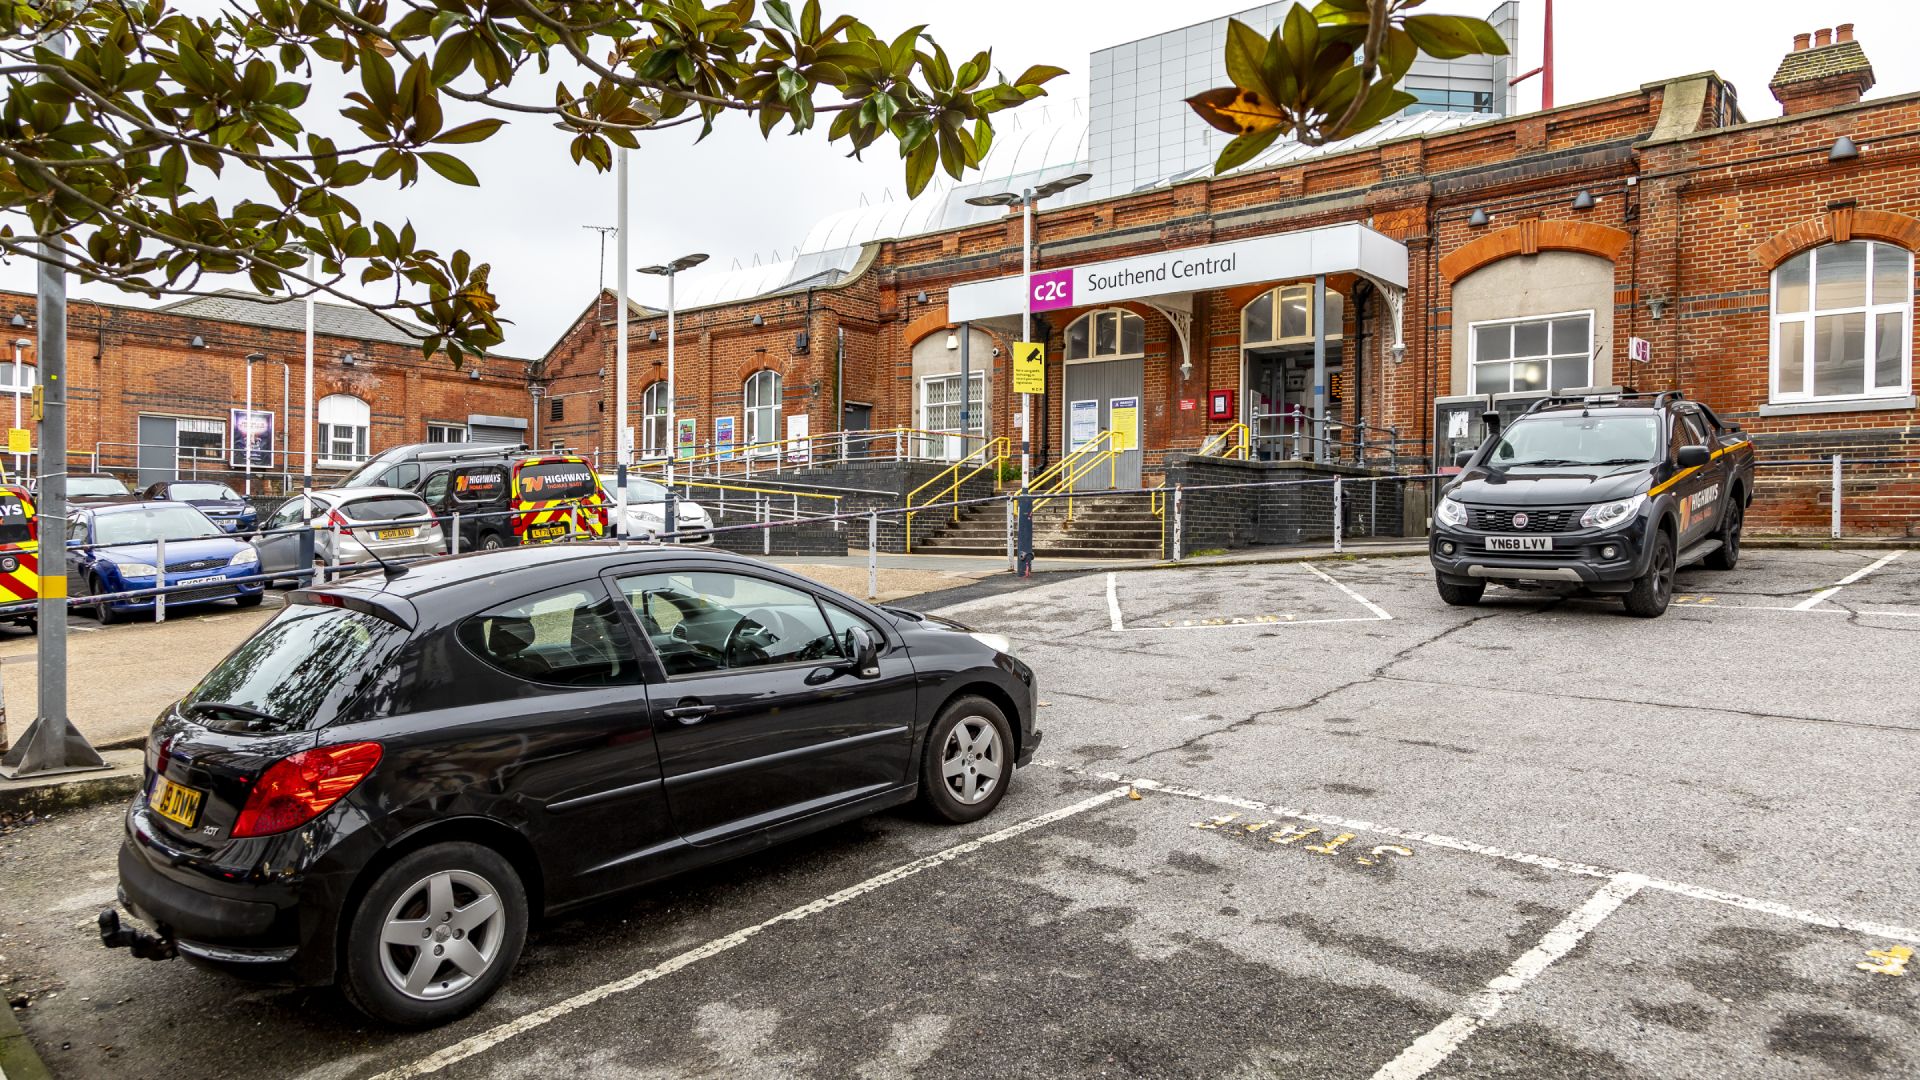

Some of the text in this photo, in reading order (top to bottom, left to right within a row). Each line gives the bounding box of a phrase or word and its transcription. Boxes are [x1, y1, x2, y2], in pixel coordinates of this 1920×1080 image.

[1033, 252, 1236, 301] c2c Southend Central
[469, 473, 502, 484] HIGHWAYS
[544, 472, 591, 484] HIGHWAYS
[0, 504, 22, 516] YS
[1490, 538, 1546, 549] YN68 LVV
[203, 825, 219, 836] 207
